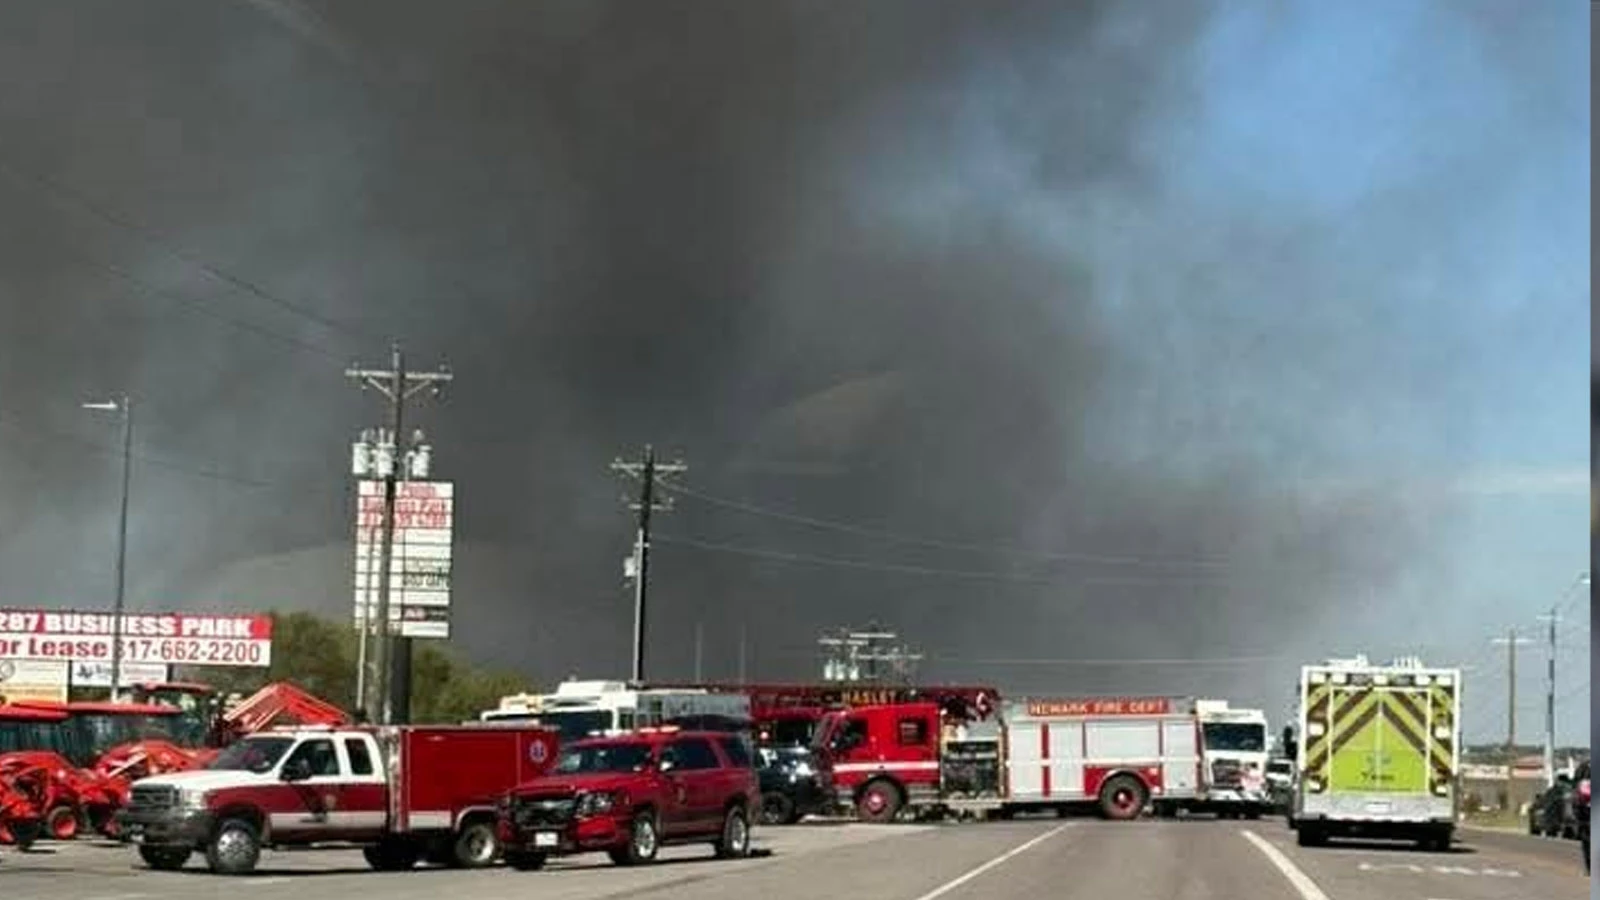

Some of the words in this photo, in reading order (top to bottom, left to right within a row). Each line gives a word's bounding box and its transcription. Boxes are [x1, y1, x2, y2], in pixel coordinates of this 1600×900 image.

[181, 617, 252, 636] PARK
[28, 638, 108, 657] Lease
[1029, 702, 1087, 715] NEWARK
[1093, 702, 1122, 714] FIRE
